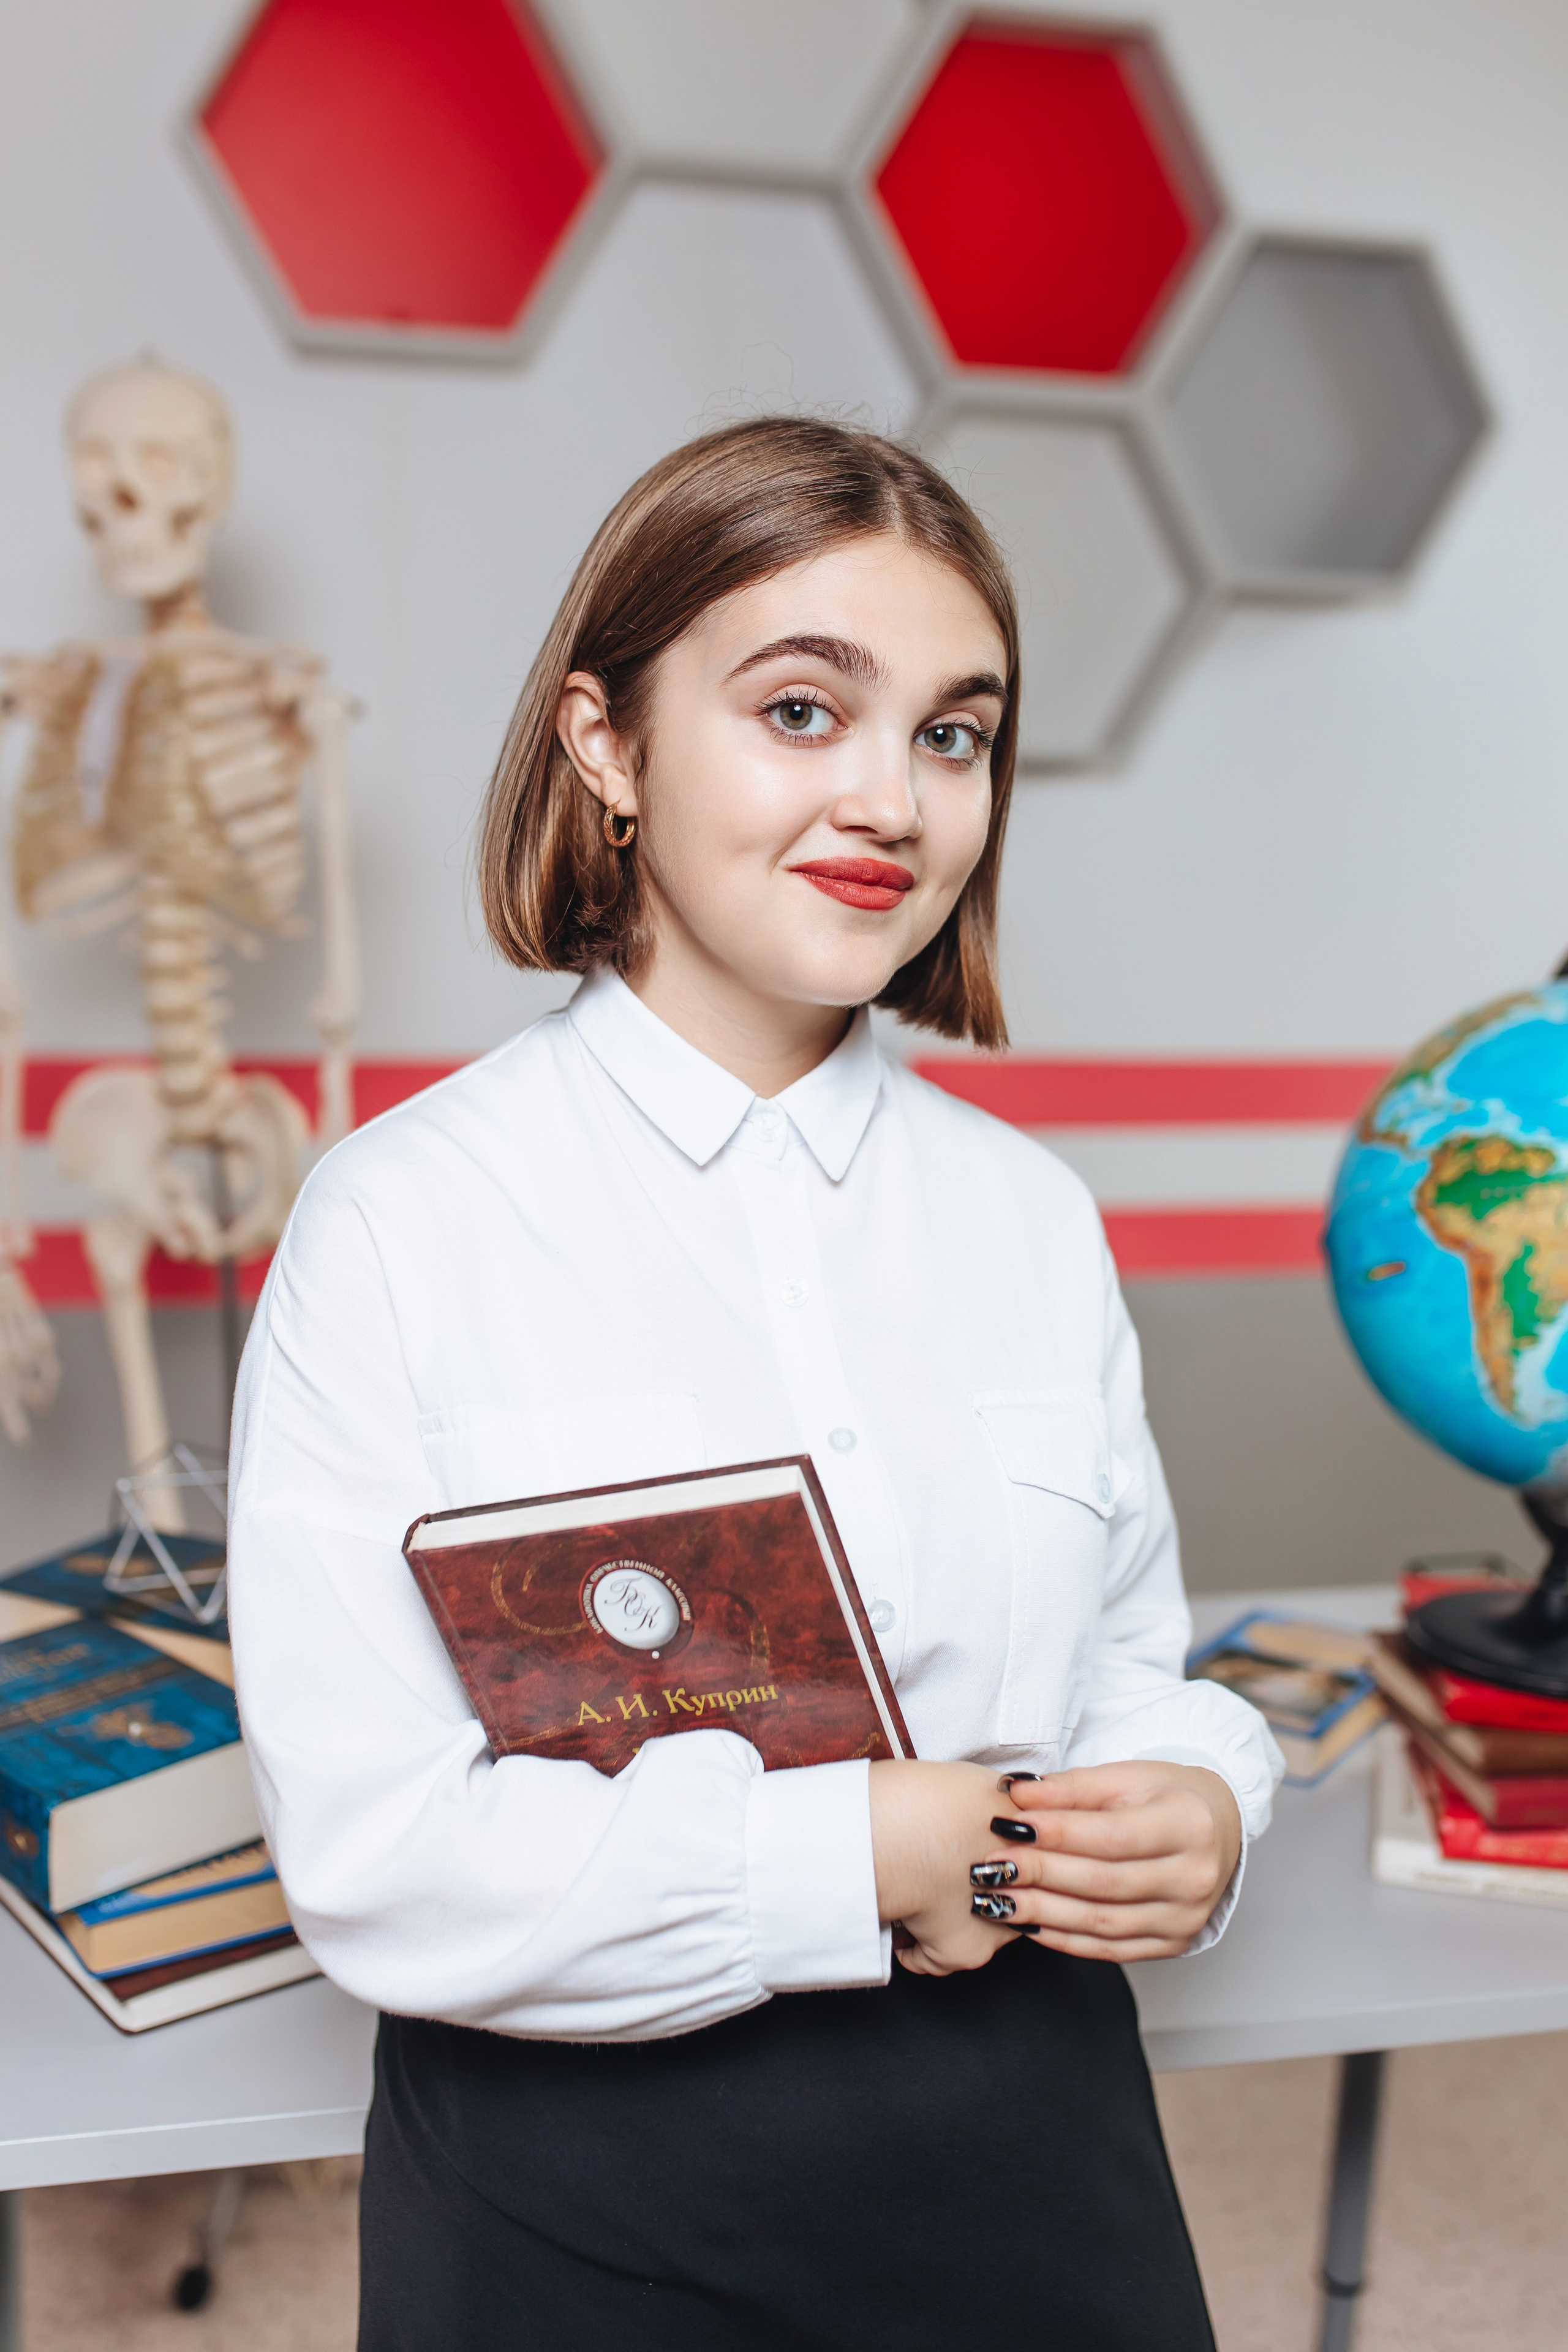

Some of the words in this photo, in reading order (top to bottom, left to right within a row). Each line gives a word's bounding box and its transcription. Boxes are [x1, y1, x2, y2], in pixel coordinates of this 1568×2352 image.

[578, 1701, 611, 1725] А.
[616, 1694, 658, 1720] И.
[662, 1684, 778, 1716] Куприн
